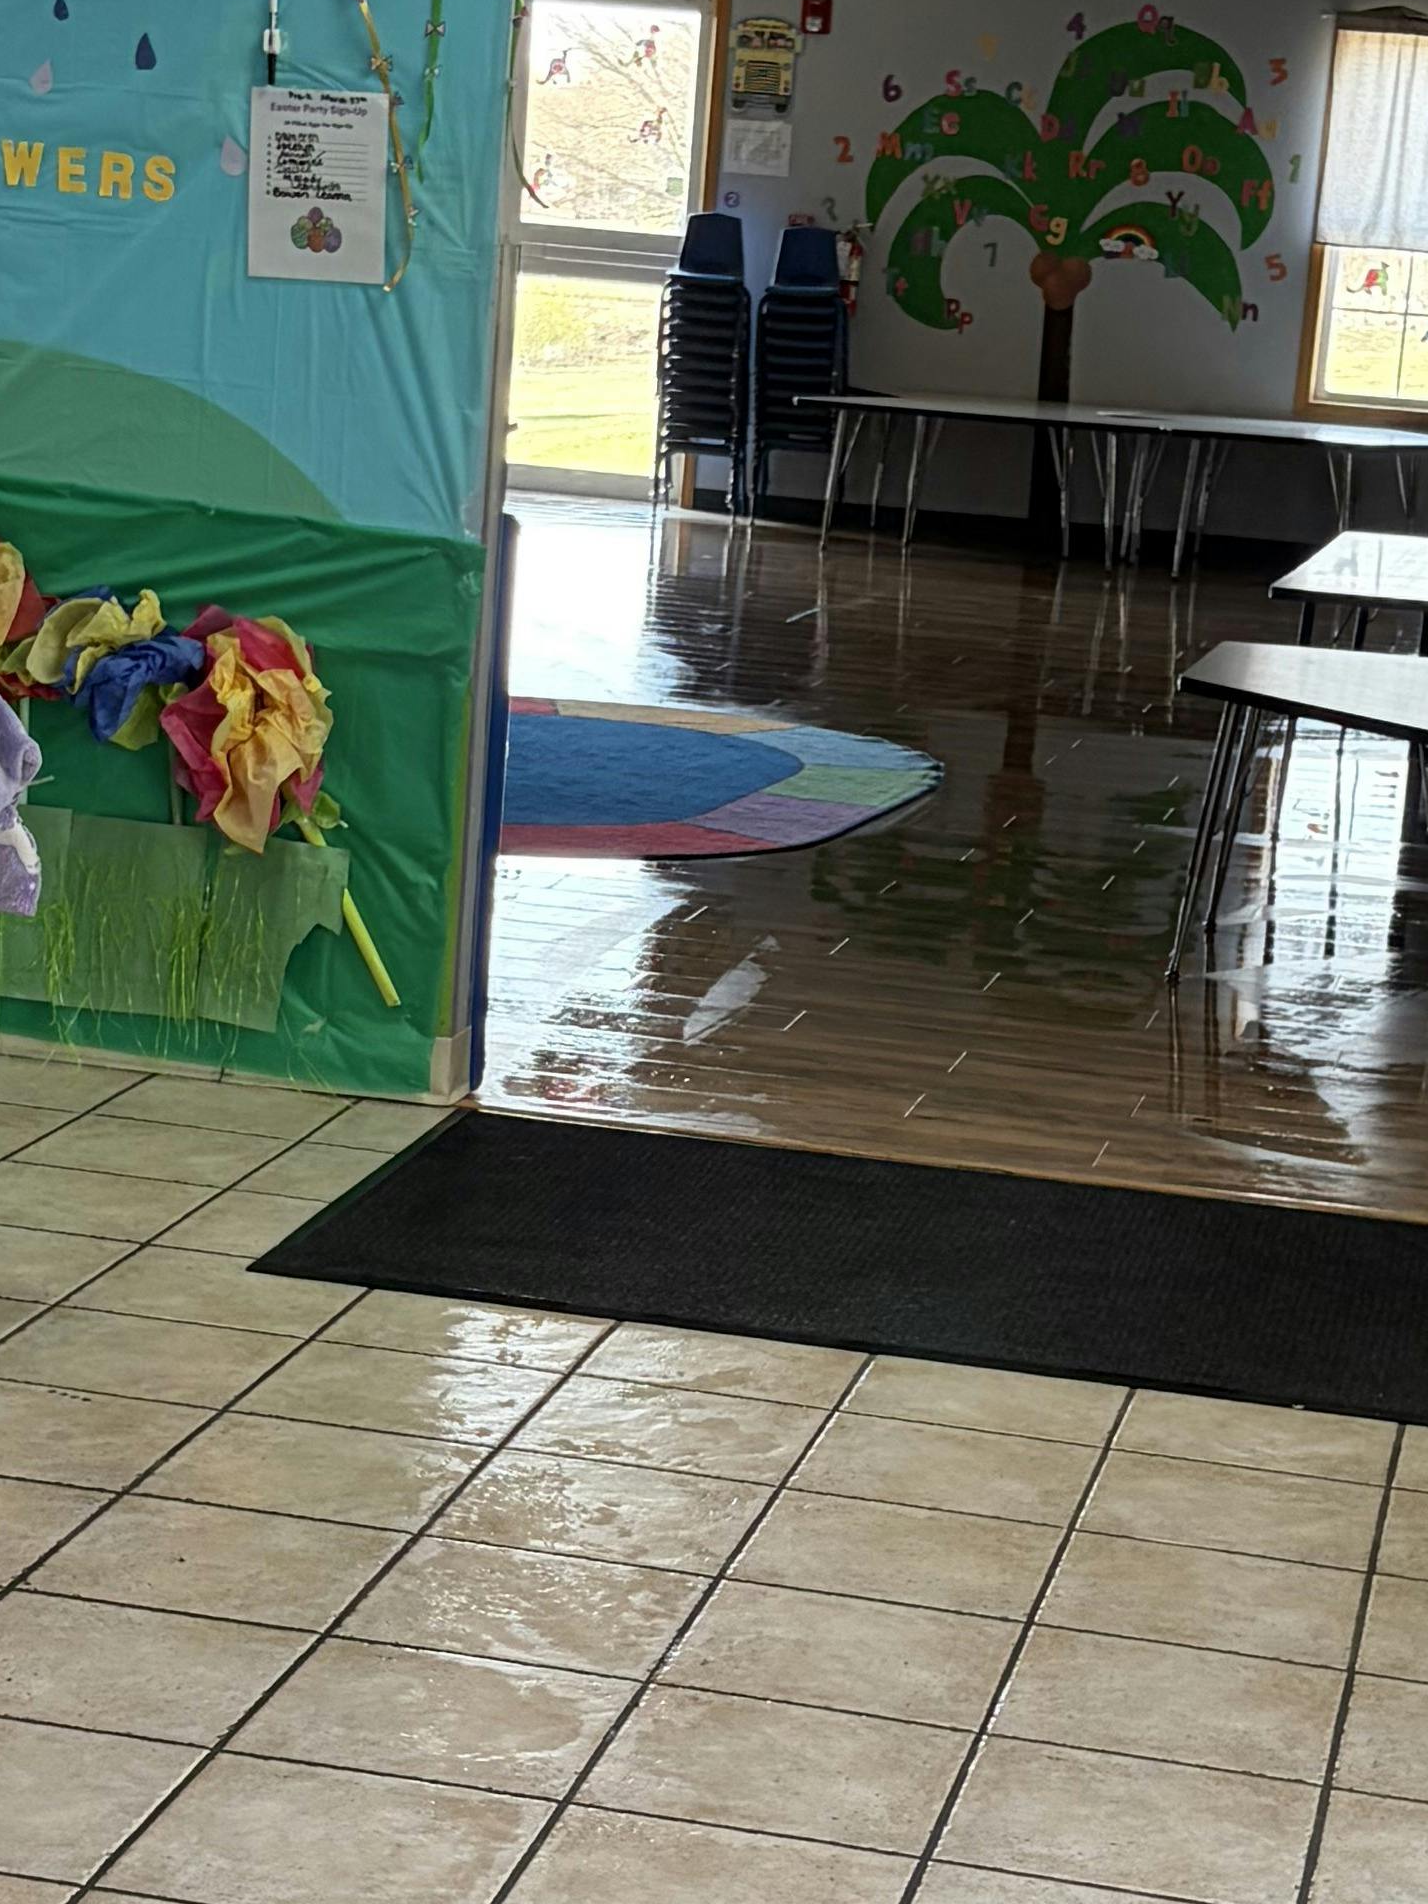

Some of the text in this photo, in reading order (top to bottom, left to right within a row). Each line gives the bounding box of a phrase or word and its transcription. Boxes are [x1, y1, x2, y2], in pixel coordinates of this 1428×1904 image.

[1067, 12, 1085, 40] 4
[1137, 4, 1177, 46] Qq
[945, 70, 977, 99] Ss
[1269, 58, 1288, 86] 3
[883, 74, 902, 103] 6
[270, 102, 369, 117] Easter Party Sign-Up
[833, 135, 853, 163] 2
[876, 132, 935, 164] Mm
[1182, 144, 1221, 176] Oo
[1068, 150, 1107, 181] Rr
[1130, 157, 1149, 187] 8
[1289, 153, 1302, 184] 1
[983, 242, 998, 268] 7
[1264, 253, 1288, 282] 5
[945, 297, 973, 334] Pp
